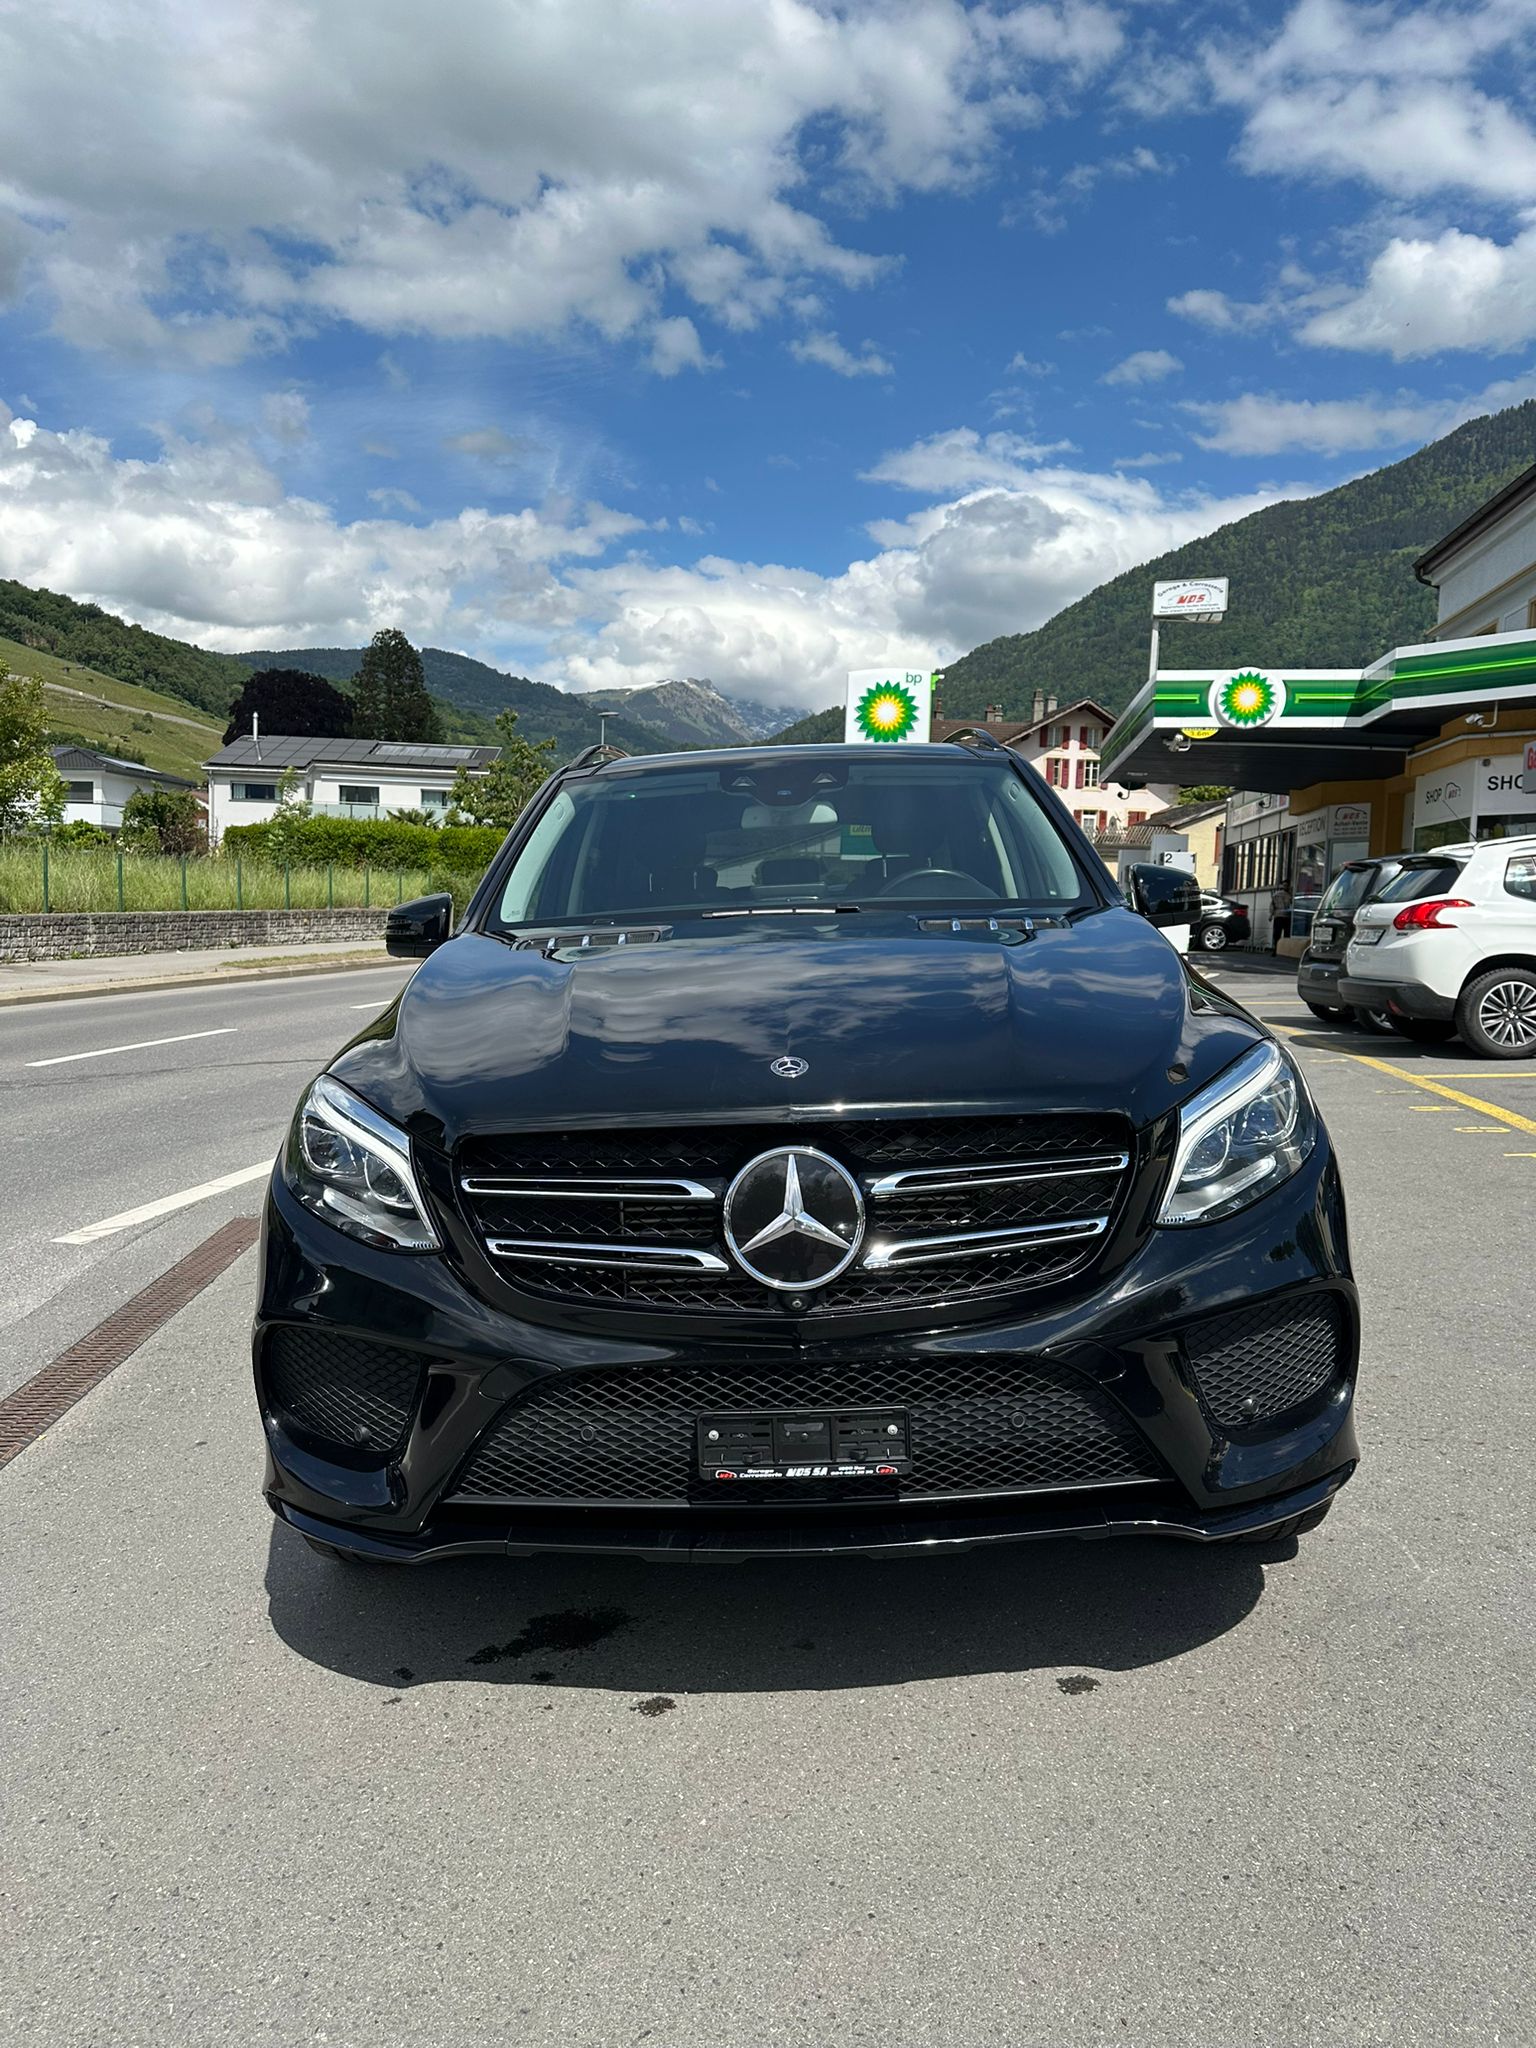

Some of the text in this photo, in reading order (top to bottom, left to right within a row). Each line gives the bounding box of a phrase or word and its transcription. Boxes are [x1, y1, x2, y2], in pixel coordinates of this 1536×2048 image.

[905, 671, 923, 686] bp
[1487, 774, 1524, 791] SHO
[1425, 788, 1442, 805] SHOP
[1165, 852, 1173, 864] 2
